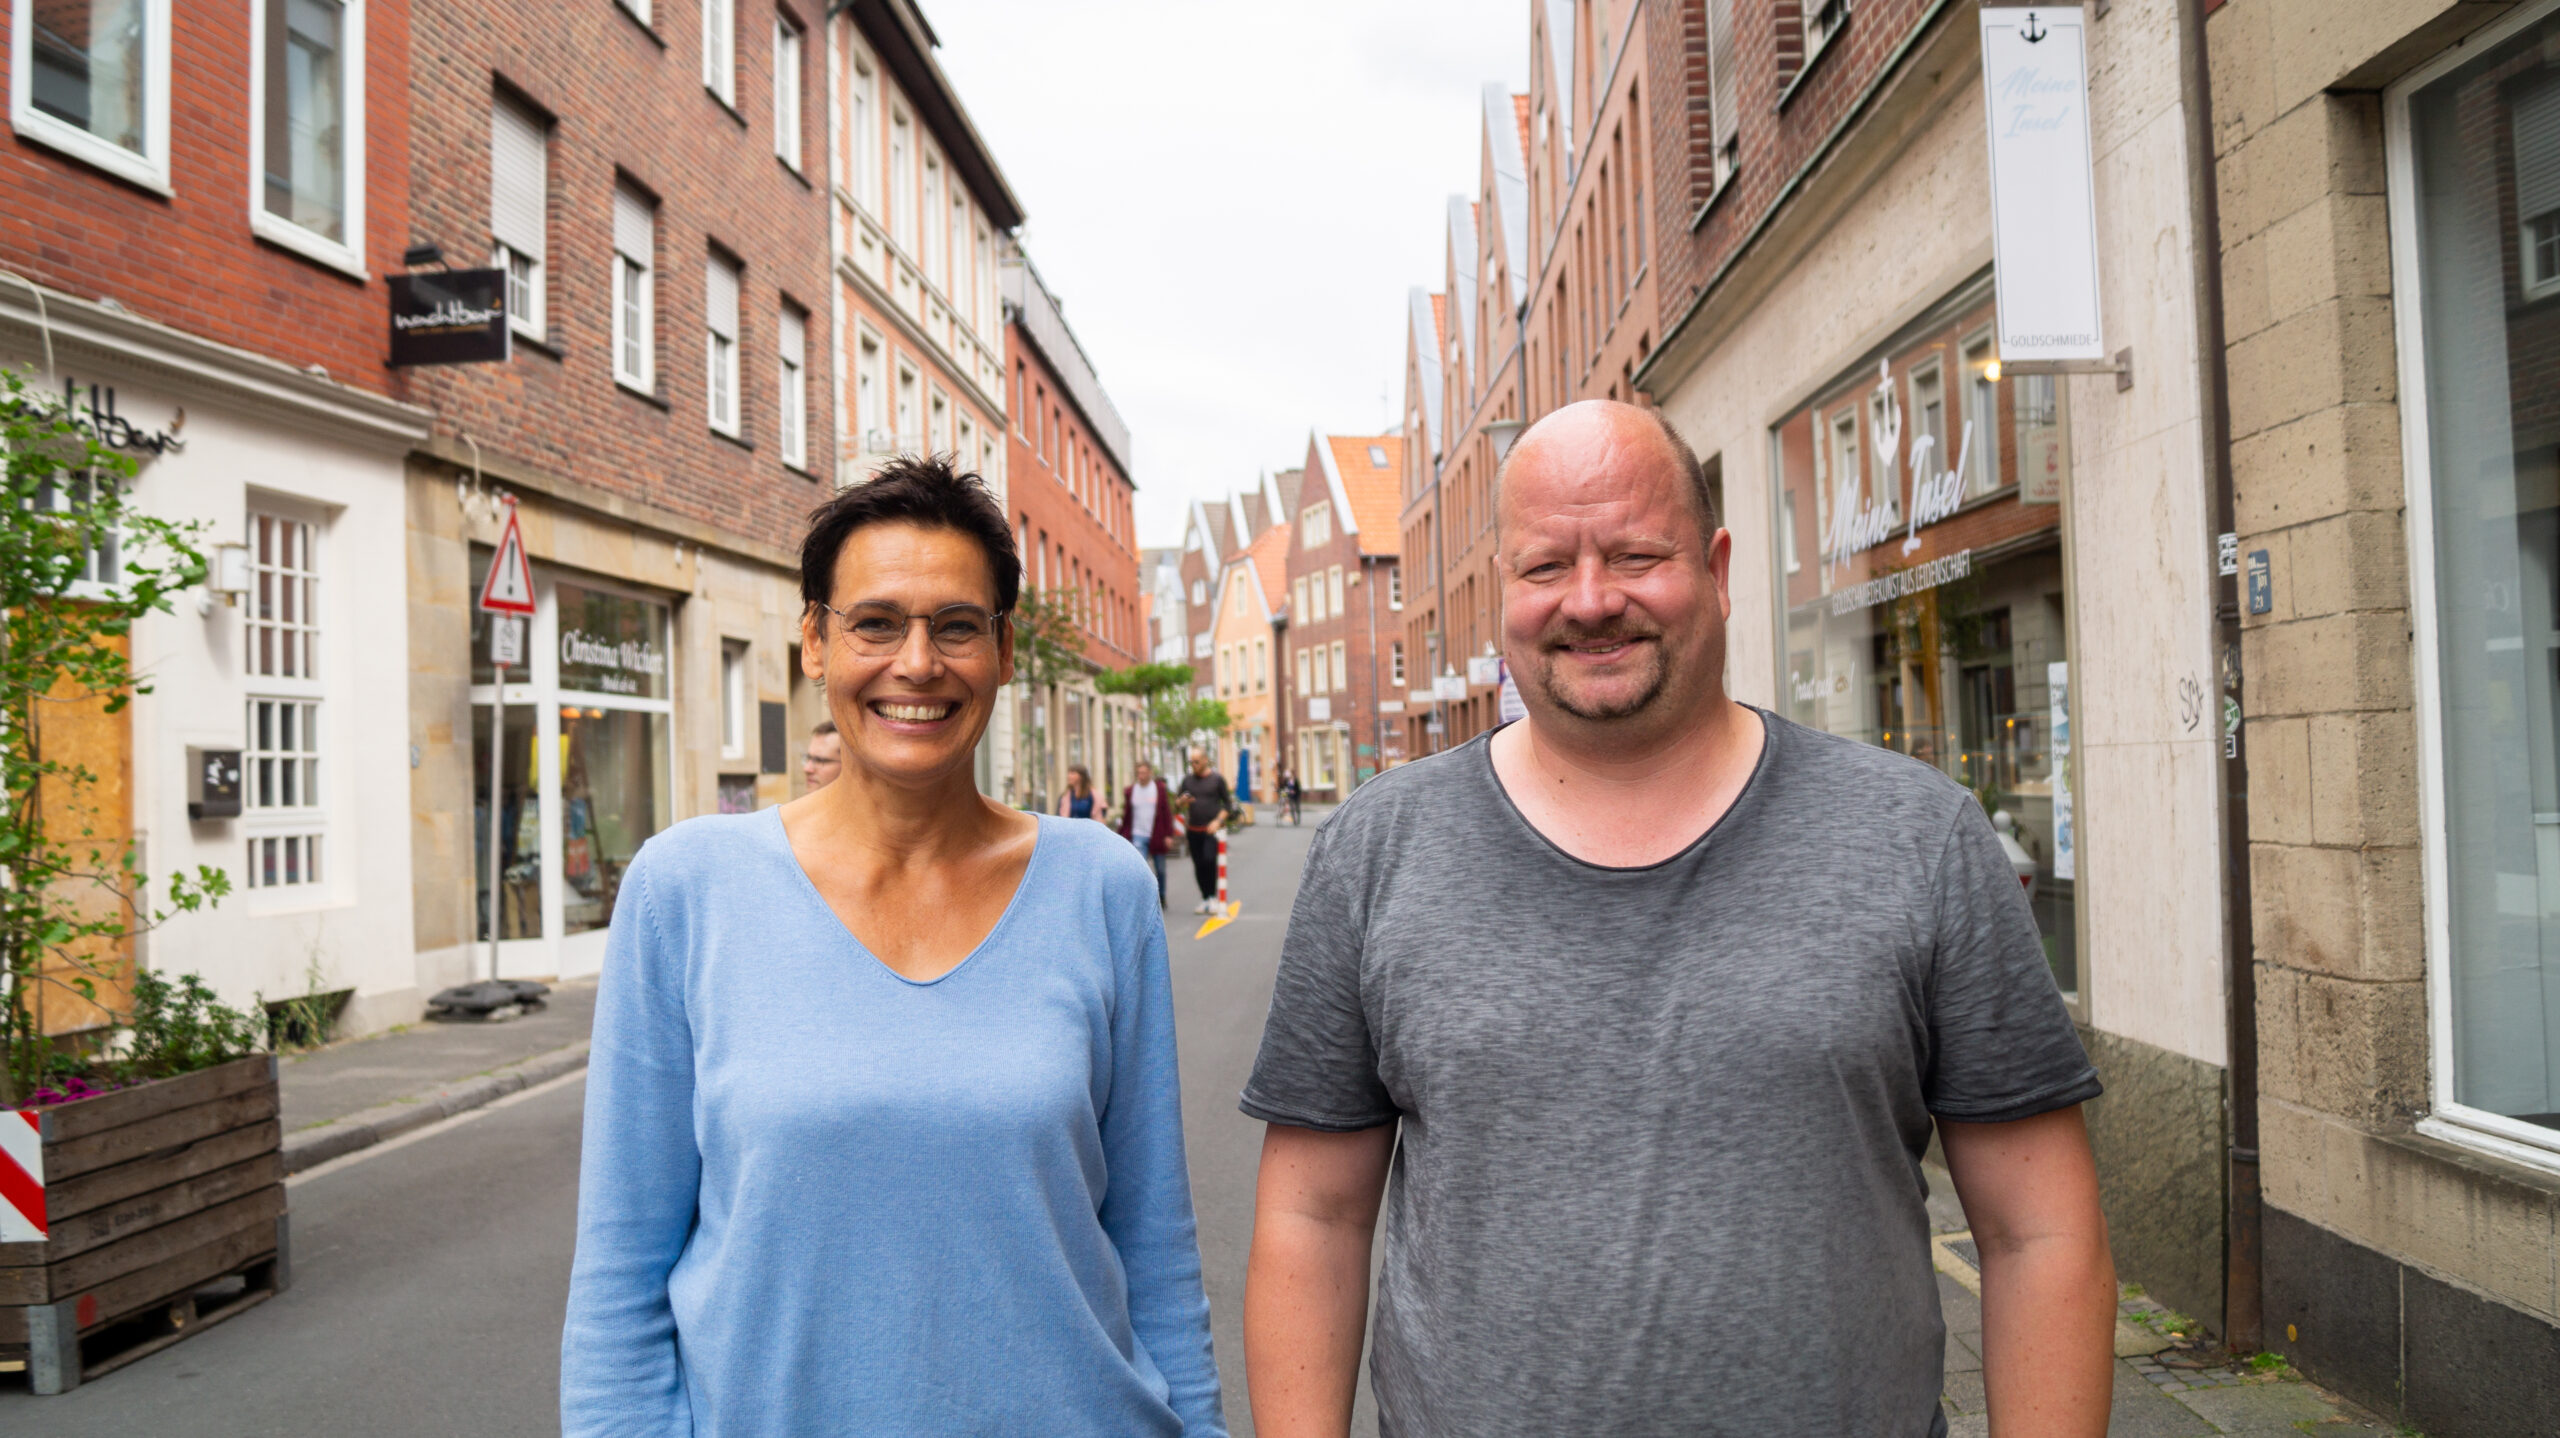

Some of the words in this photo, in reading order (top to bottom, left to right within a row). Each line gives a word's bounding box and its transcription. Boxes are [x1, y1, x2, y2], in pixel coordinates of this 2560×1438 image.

[1996, 66, 2078, 102] Meine
[2003, 103, 2070, 138] Insel
[395, 299, 503, 330] nachtbar
[2010, 333, 2093, 348] GOLDSCHMIEDE
[1825, 470, 1895, 585] Meine
[1903, 419, 1973, 558] Insel
[1832, 573, 1901, 617] GOLDSCHMIEDEKUNST
[1901, 566, 1916, 596] AUS
[1916, 548, 1971, 592] LEIDENSCHAFT
[562, 628, 619, 668] Christina
